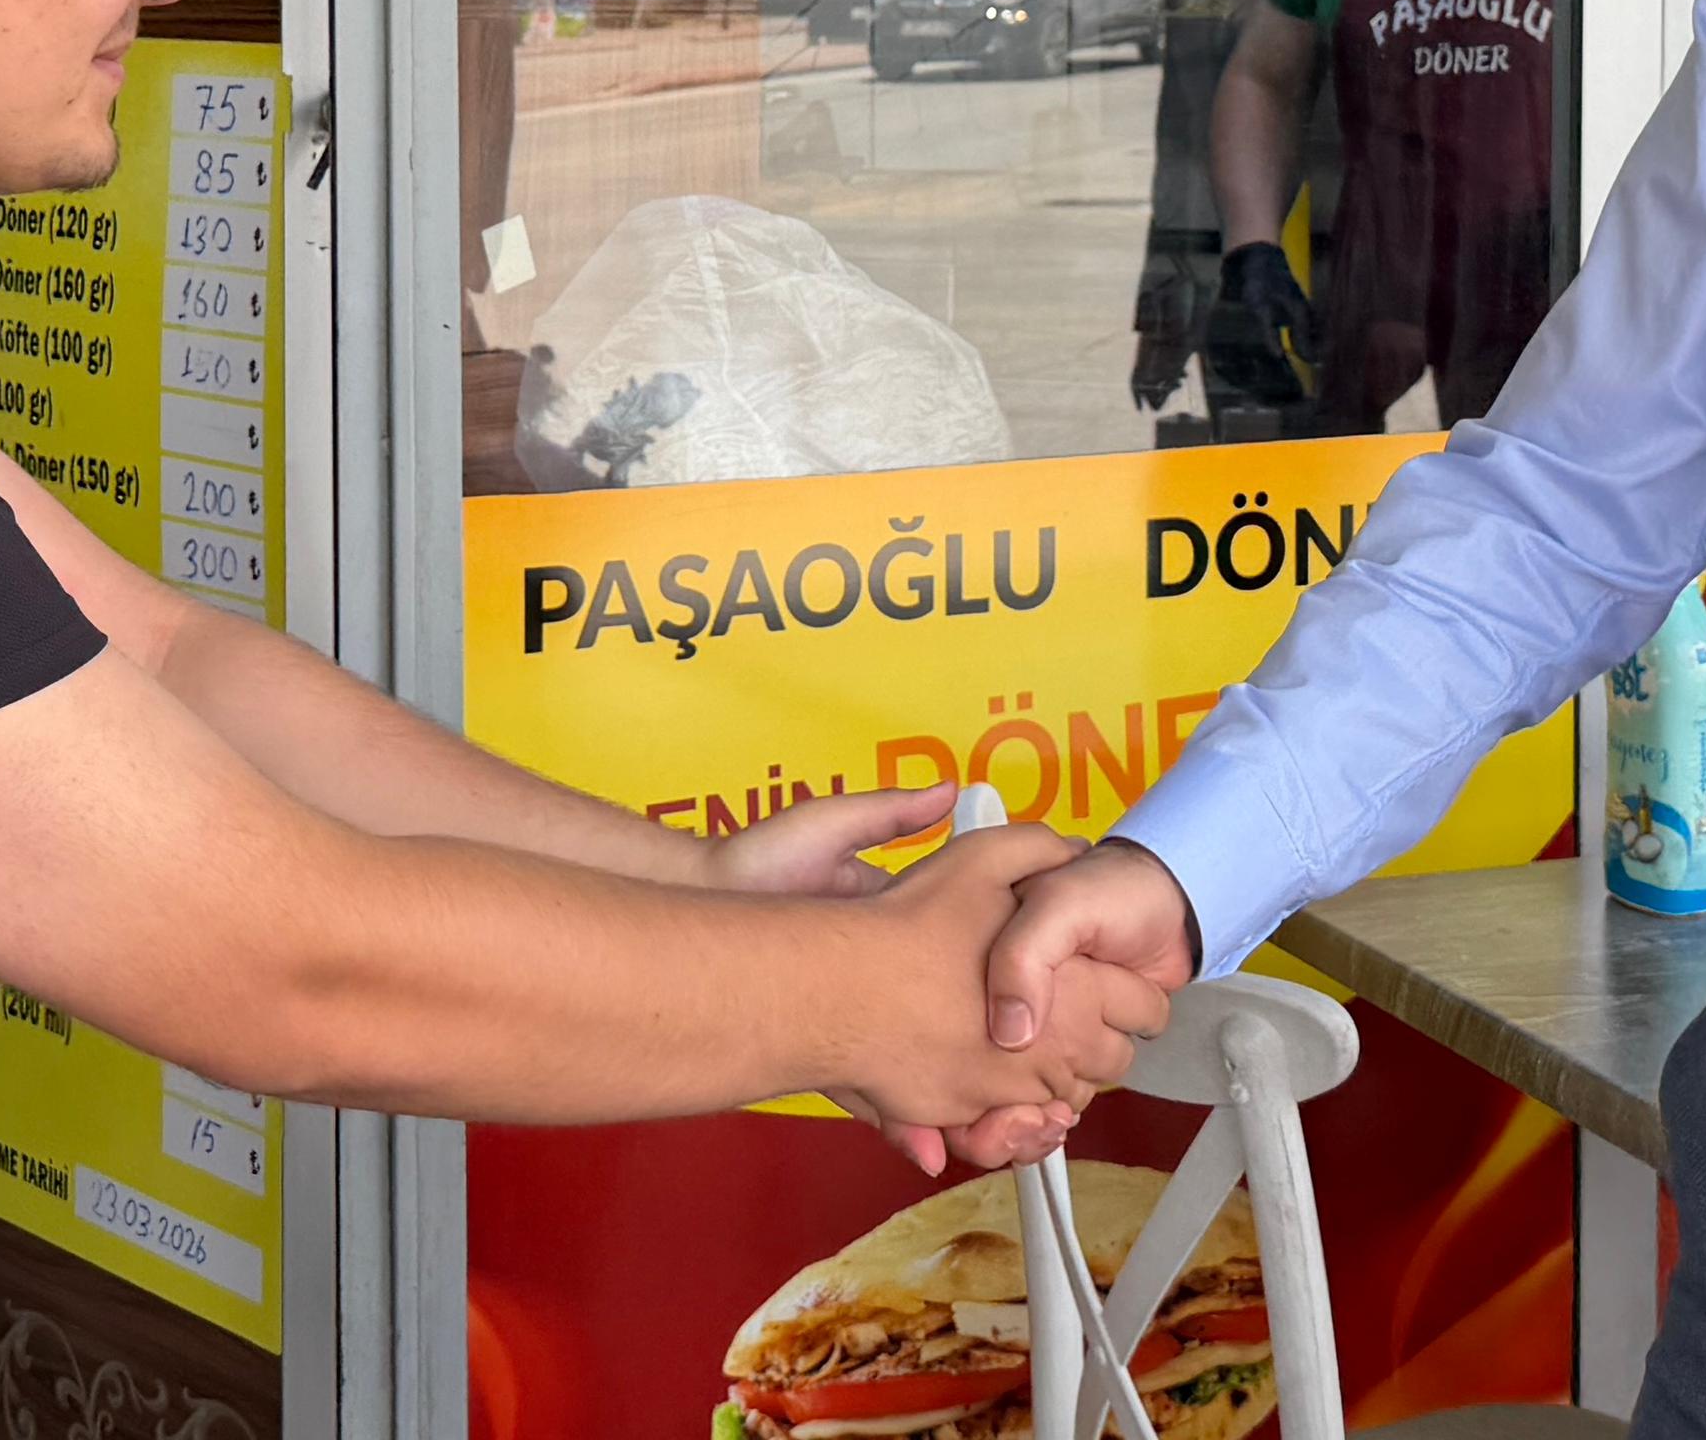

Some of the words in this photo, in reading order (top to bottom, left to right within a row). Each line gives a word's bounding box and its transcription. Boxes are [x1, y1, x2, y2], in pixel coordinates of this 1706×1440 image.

[1414, 42, 1509, 75] DÖNER
[195, 85, 245, 131] 75
[195, 149, 239, 194] 85
[50, 204, 88, 244] (120
[93, 210, 117, 252] gr)
[181, 215, 232, 255] 130
[47, 265, 85, 305] (160
[90, 272, 116, 315] gr)
[45, 326, 83, 367] (100
[87, 336, 113, 377] gr)
[29, 387, 53, 428] gr)
[70, 455, 109, 494] (150
[115, 465, 140, 508] gr)
[182, 471, 235, 517] 200
[181, 538, 237, 583] 300
[524, 515, 1057, 660] PAŞAOĞLU
[1146, 491, 1371, 600] DÖN
[876, 690, 1220, 852] DÖNE
[190, 1117, 223, 1153] 15
[22, 1158, 69, 1201] TARİHİ
